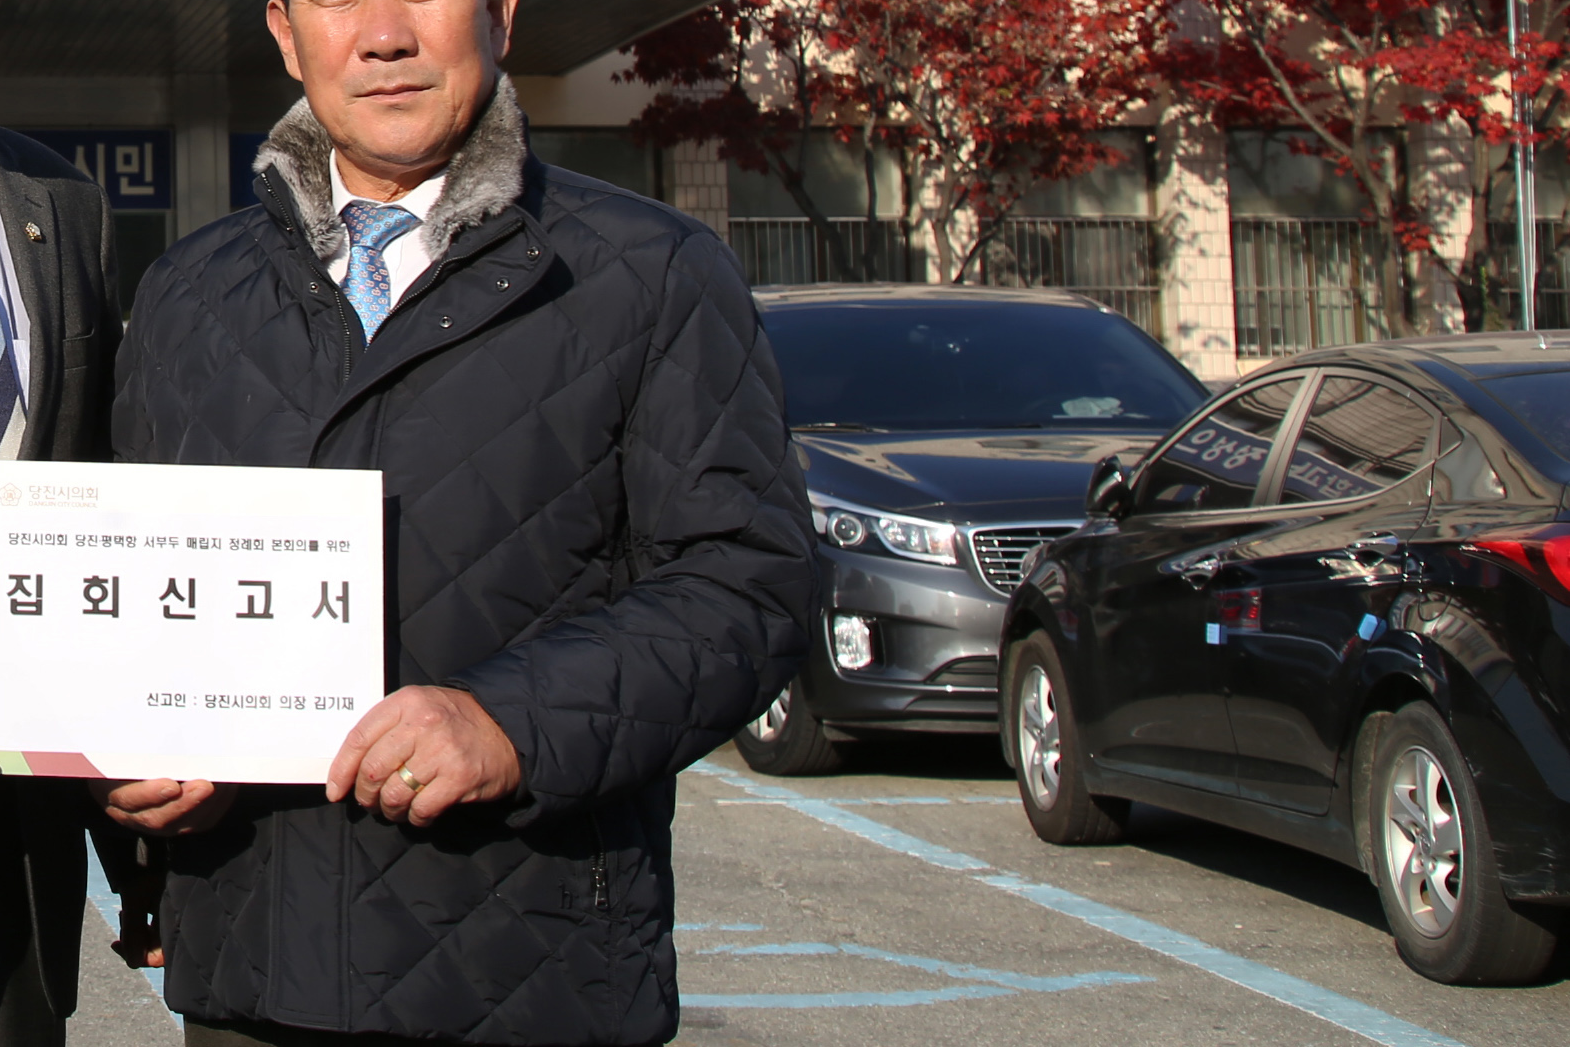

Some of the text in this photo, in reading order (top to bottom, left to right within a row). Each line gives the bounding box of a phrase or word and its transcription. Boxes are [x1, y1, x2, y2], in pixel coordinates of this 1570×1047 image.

[28, 485, 99, 501] 당진시의회
[8, 532, 68, 546] 당진시의회
[143, 536, 179, 549] 서부두
[186, 536, 222, 550] 매립지
[229, 538, 265, 551] 정례회
[271, 539, 319, 552] 본회의를
[326, 540, 351, 553] 위한
[146, 692, 186, 708] 신고인
[204, 694, 271, 709] 당진시의회
[279, 695, 307, 710] 의장
[314, 696, 354, 711] 김기재
